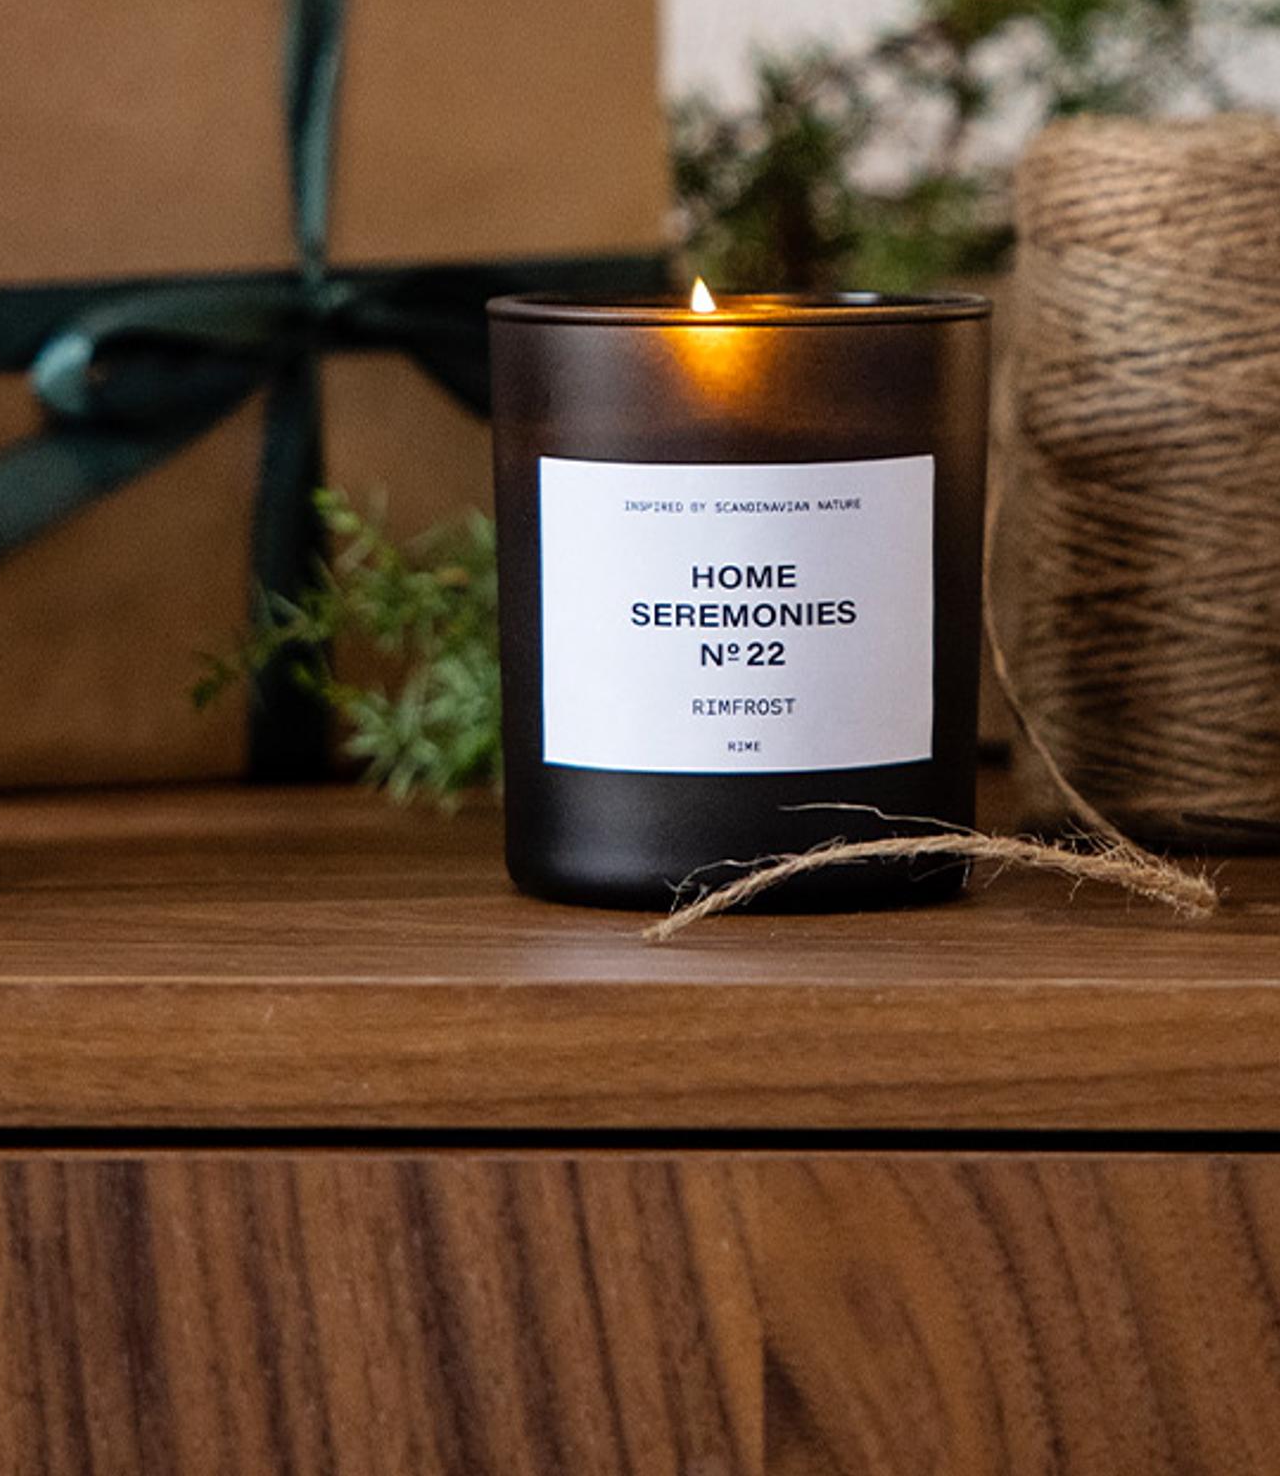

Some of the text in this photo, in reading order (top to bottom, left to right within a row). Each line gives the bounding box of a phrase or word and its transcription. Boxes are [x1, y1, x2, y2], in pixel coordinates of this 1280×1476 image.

[625, 499, 861, 513] INSPIRED BY SCANDINAVIAN NATURE
[692, 565, 797, 588] HOME
[631, 601, 857, 627] SEREMONIES
[693, 698, 796, 716] RIMFROST
[728, 741, 761, 752] RIME
